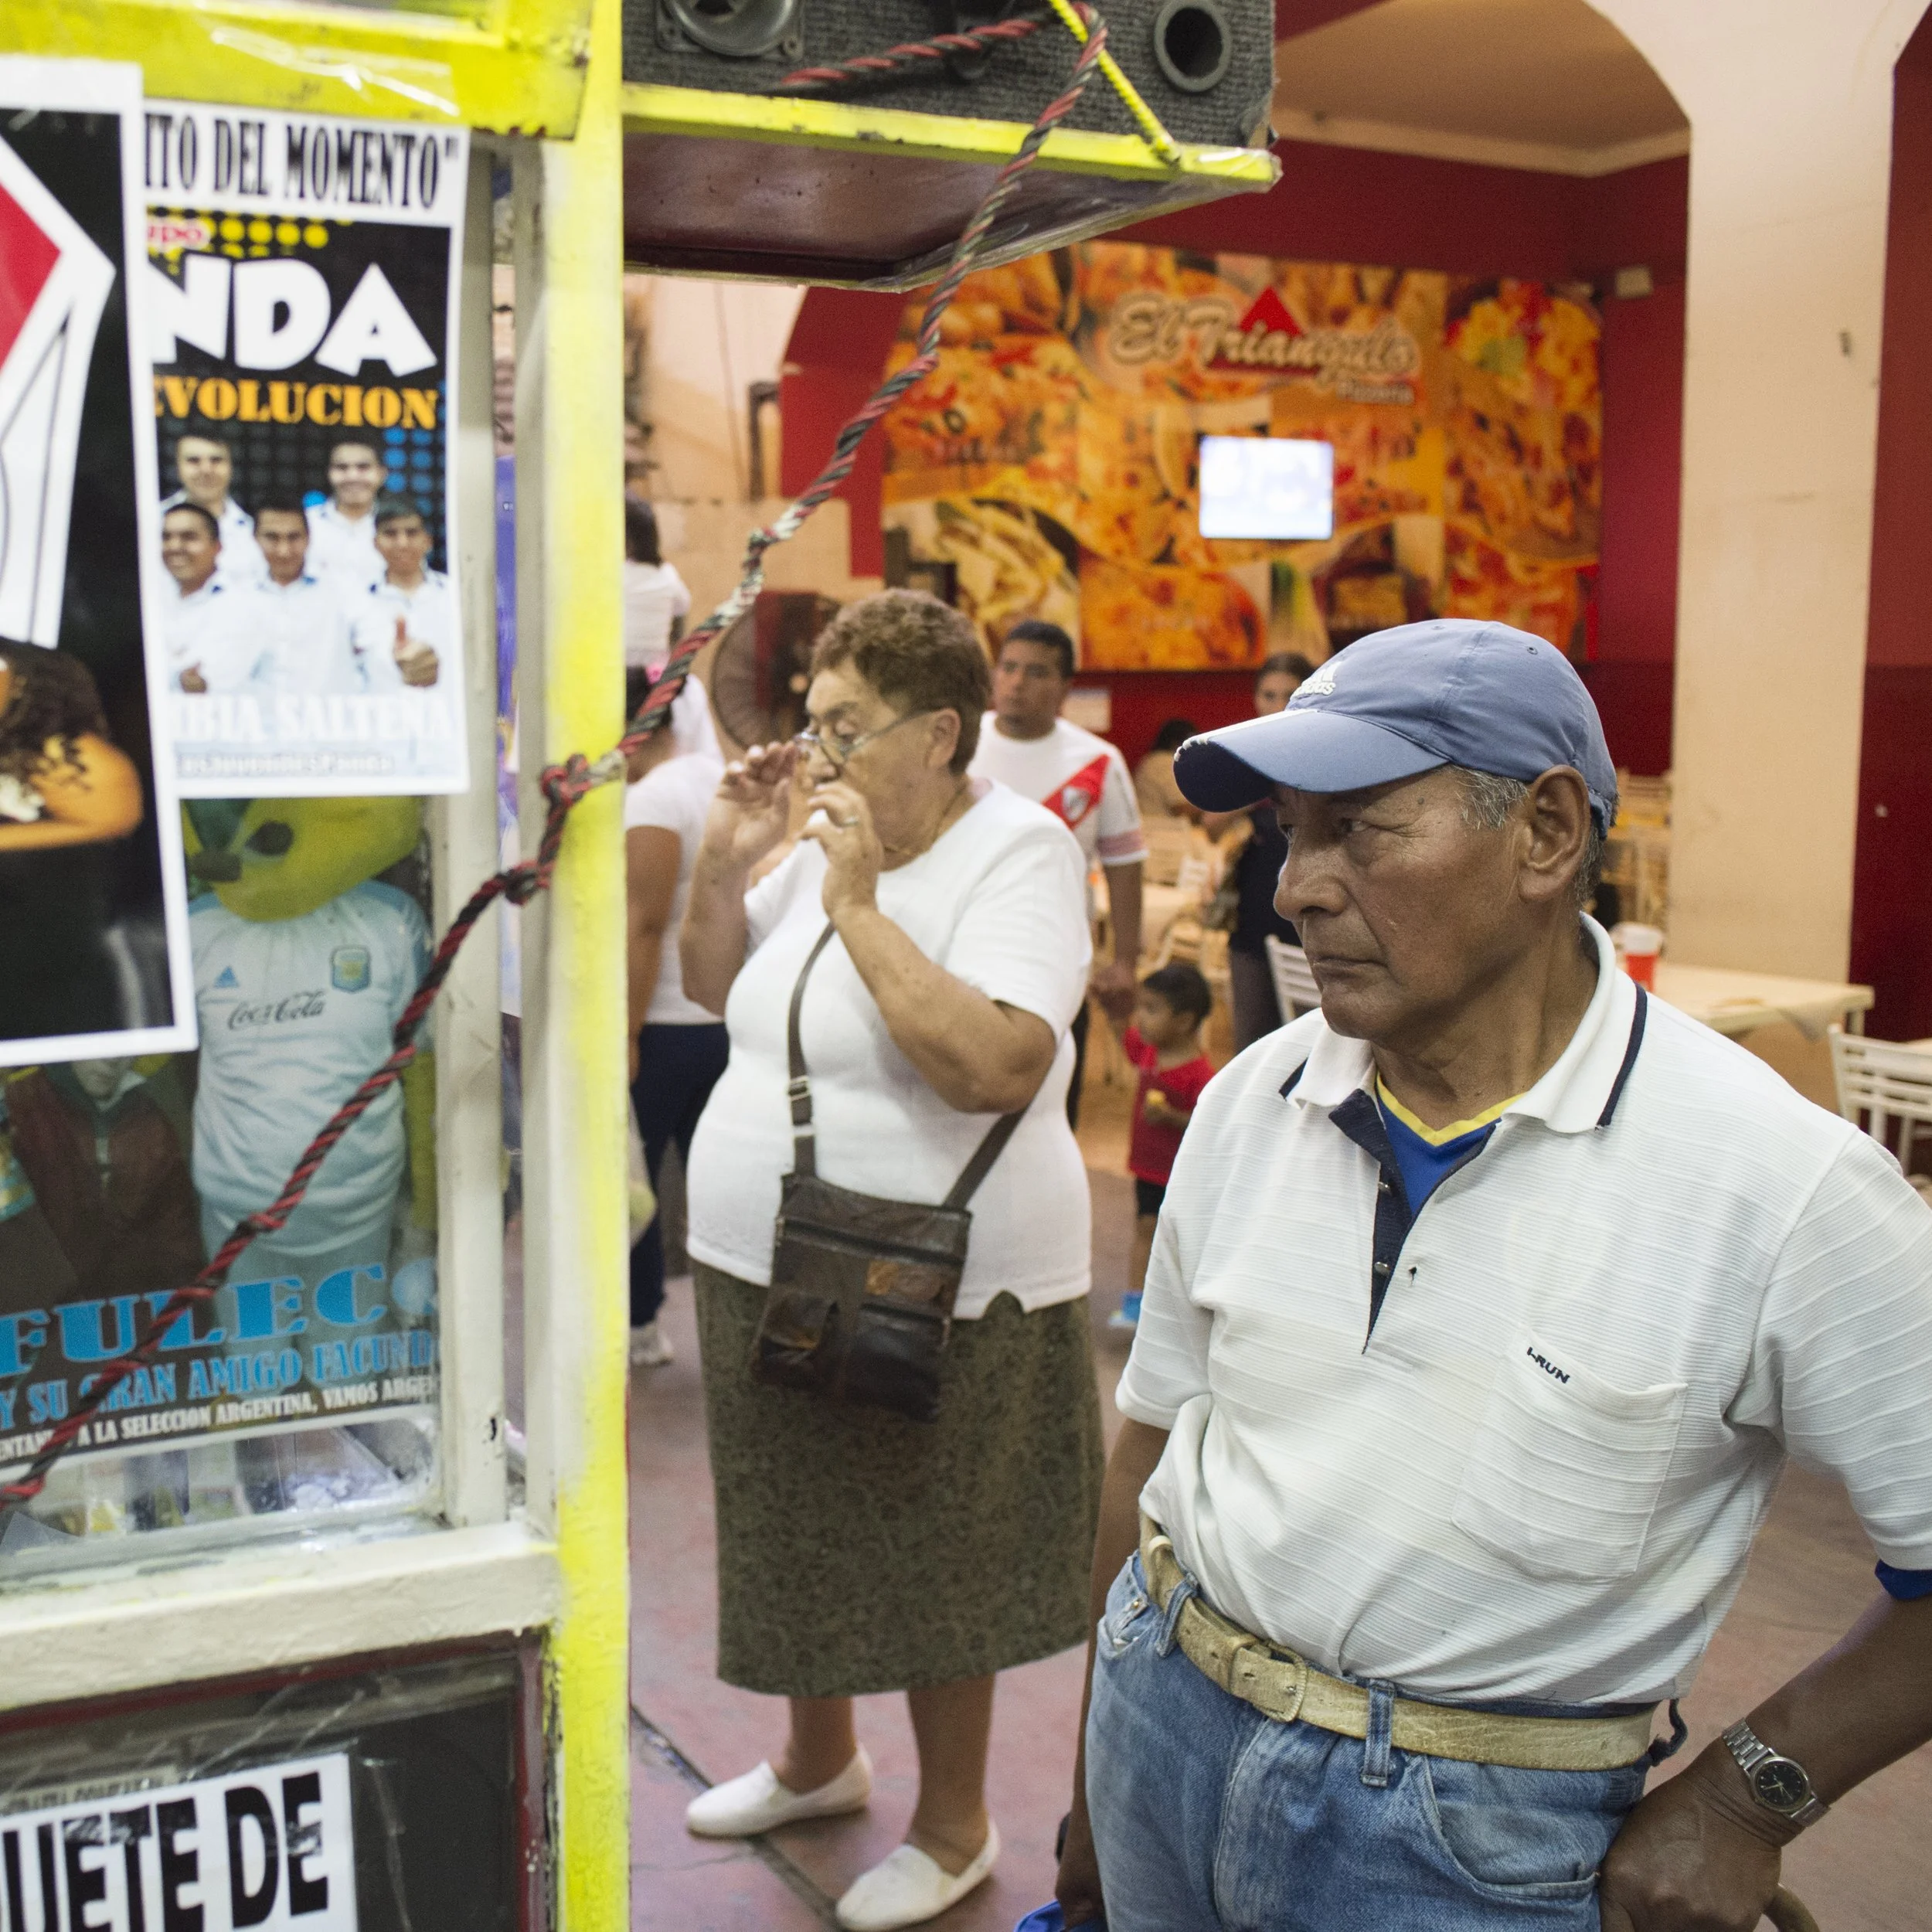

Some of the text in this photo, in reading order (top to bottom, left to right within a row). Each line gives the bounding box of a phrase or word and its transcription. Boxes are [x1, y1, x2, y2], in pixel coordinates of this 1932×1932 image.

[213, 119, 268, 195] DEL
[148, 253, 437, 378] NDA
[0, 1263, 387, 1378] FULEC
[26, 1378, 70, 1426] SU
[188, 1349, 304, 1401] AMIGO
[94, 1417, 118, 1446] LA
[121, 1403, 213, 1439] SELECCION
[323, 1379, 379, 1410] VAMOS
[224, 1770, 328, 1929] DE
